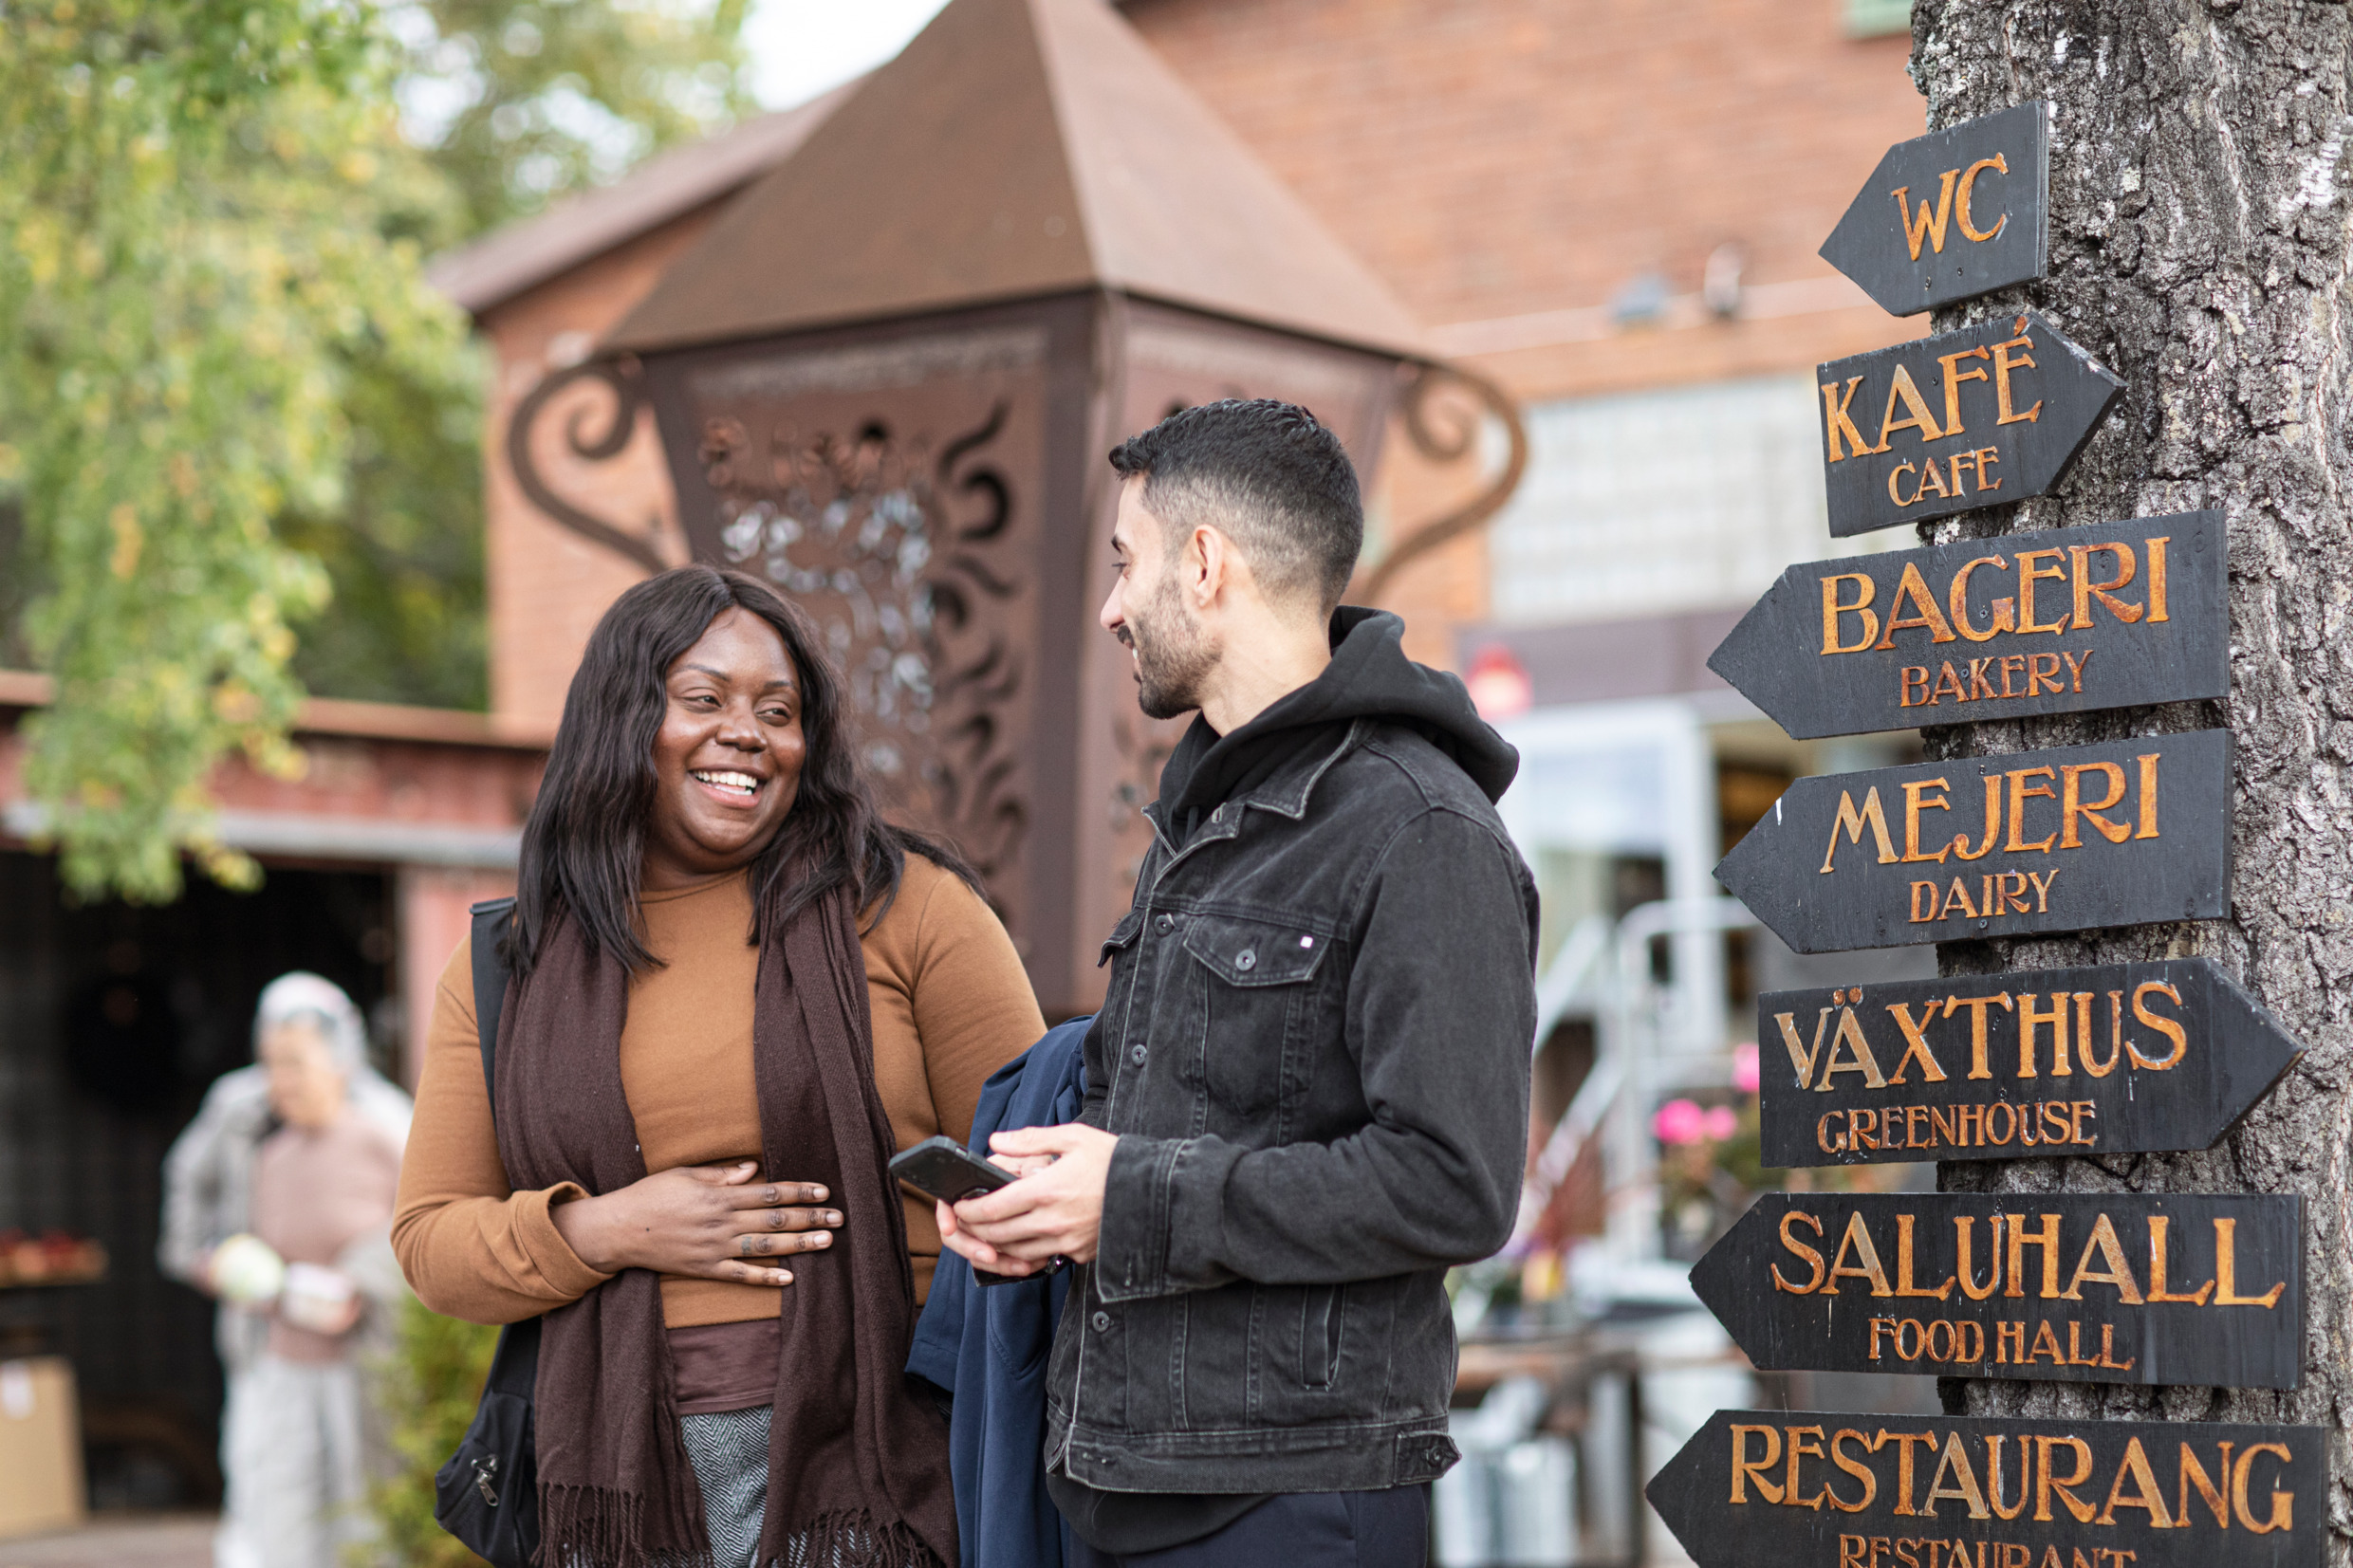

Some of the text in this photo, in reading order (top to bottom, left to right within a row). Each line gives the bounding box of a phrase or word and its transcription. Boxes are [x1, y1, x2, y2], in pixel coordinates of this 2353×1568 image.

[1892, 153, 2009, 261] WC
[1820, 315, 2043, 463] KAFÉ
[1887, 445, 2003, 507] CAFE
[1819, 536, 2171, 656] BAGERI
[1900, 650, 2093, 708] BAKERY
[1819, 752, 2161, 875] MEJERI
[1909, 869, 2059, 922] DAIRY
[1774, 983, 2187, 1091] VÄXTHUS
[1817, 1100, 2095, 1153] GREENHOUSE
[1770, 1211, 2286, 1309] SALUHALL
[1868, 1318, 2135, 1371] FOOD HALL
[1729, 1424, 2294, 1535] RESTAURANG
